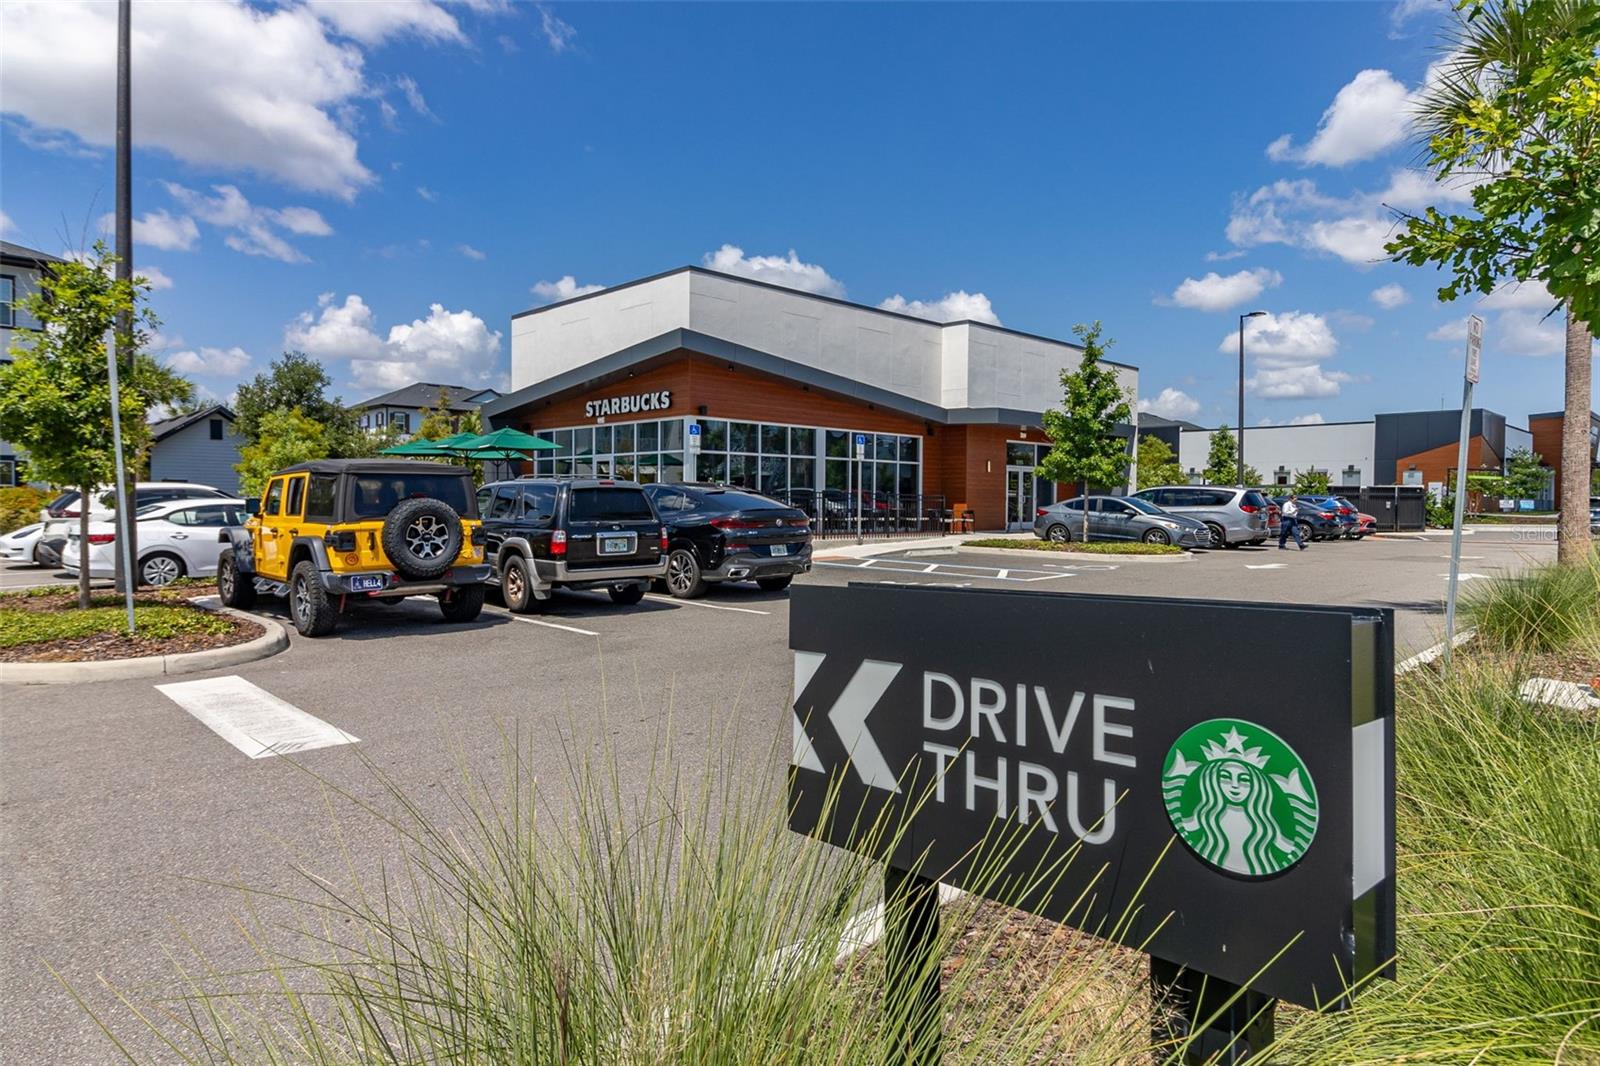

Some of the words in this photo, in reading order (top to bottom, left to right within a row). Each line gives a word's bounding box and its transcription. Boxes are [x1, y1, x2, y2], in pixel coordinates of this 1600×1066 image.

[585, 391, 671, 417] STARBUCKS
[923, 671, 1137, 768] DRIVE
[923, 741, 1117, 845] THRU
